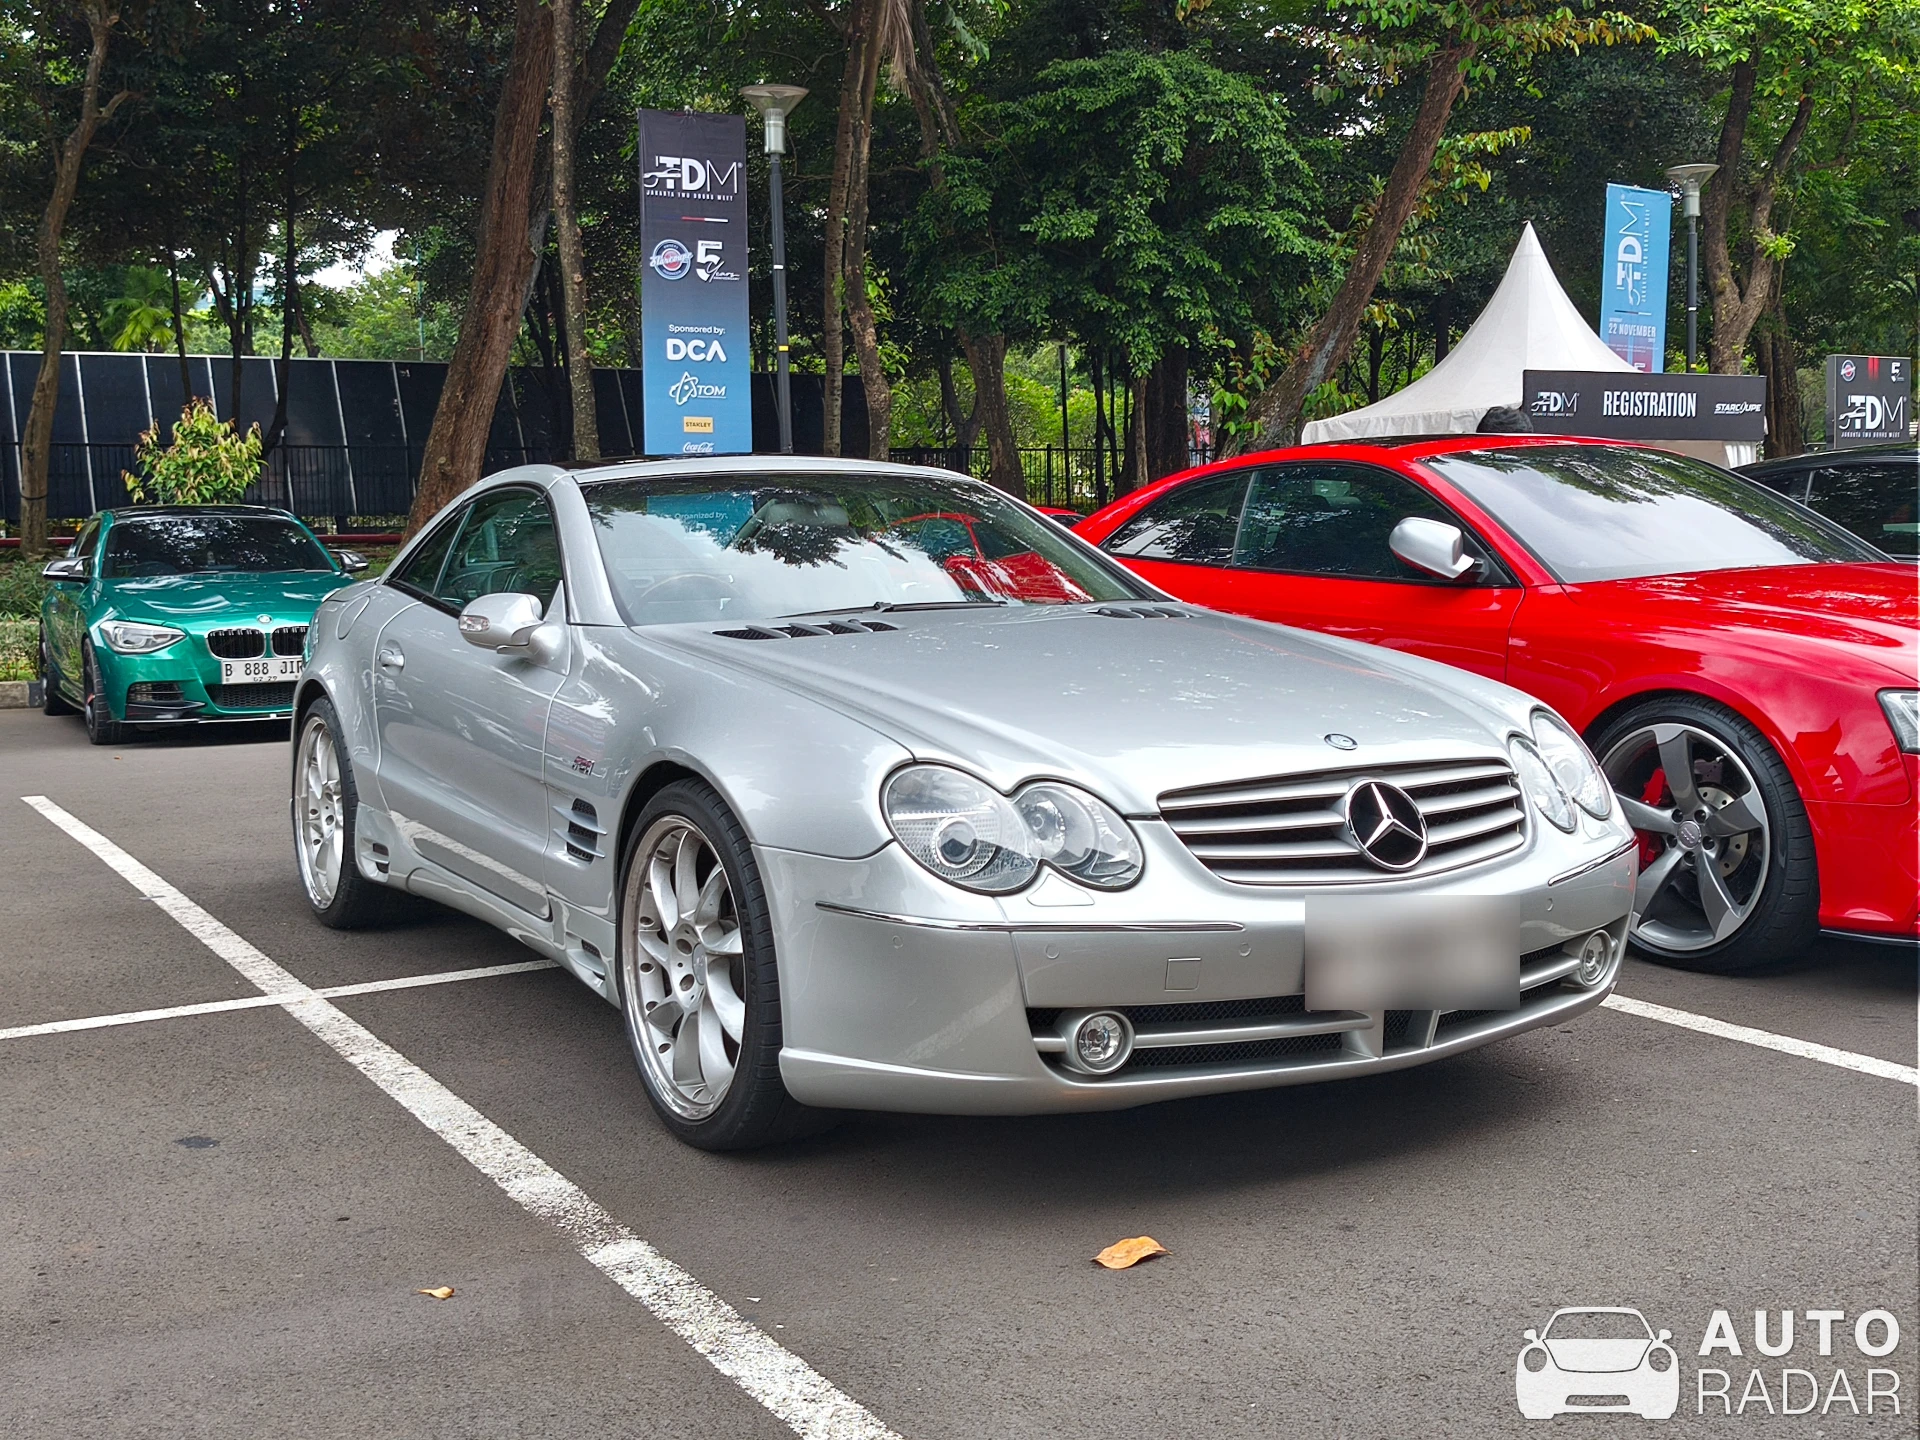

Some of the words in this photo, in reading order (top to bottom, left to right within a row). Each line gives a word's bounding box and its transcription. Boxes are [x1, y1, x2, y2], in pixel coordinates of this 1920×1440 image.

[696, 240, 723, 282] 5
[668, 324, 713, 334] Sponsored
[713, 325, 726, 335] by:
[1608, 323, 1617, 334] 22
[1618, 324, 1656, 337] NOVEMBER
[666, 338, 727, 363] DCA
[1602, 390, 1697, 418] REGISTRATION
[674, 511, 715, 520] Organized
[224, 663, 233, 677] B
[244, 662, 269, 676] 888
